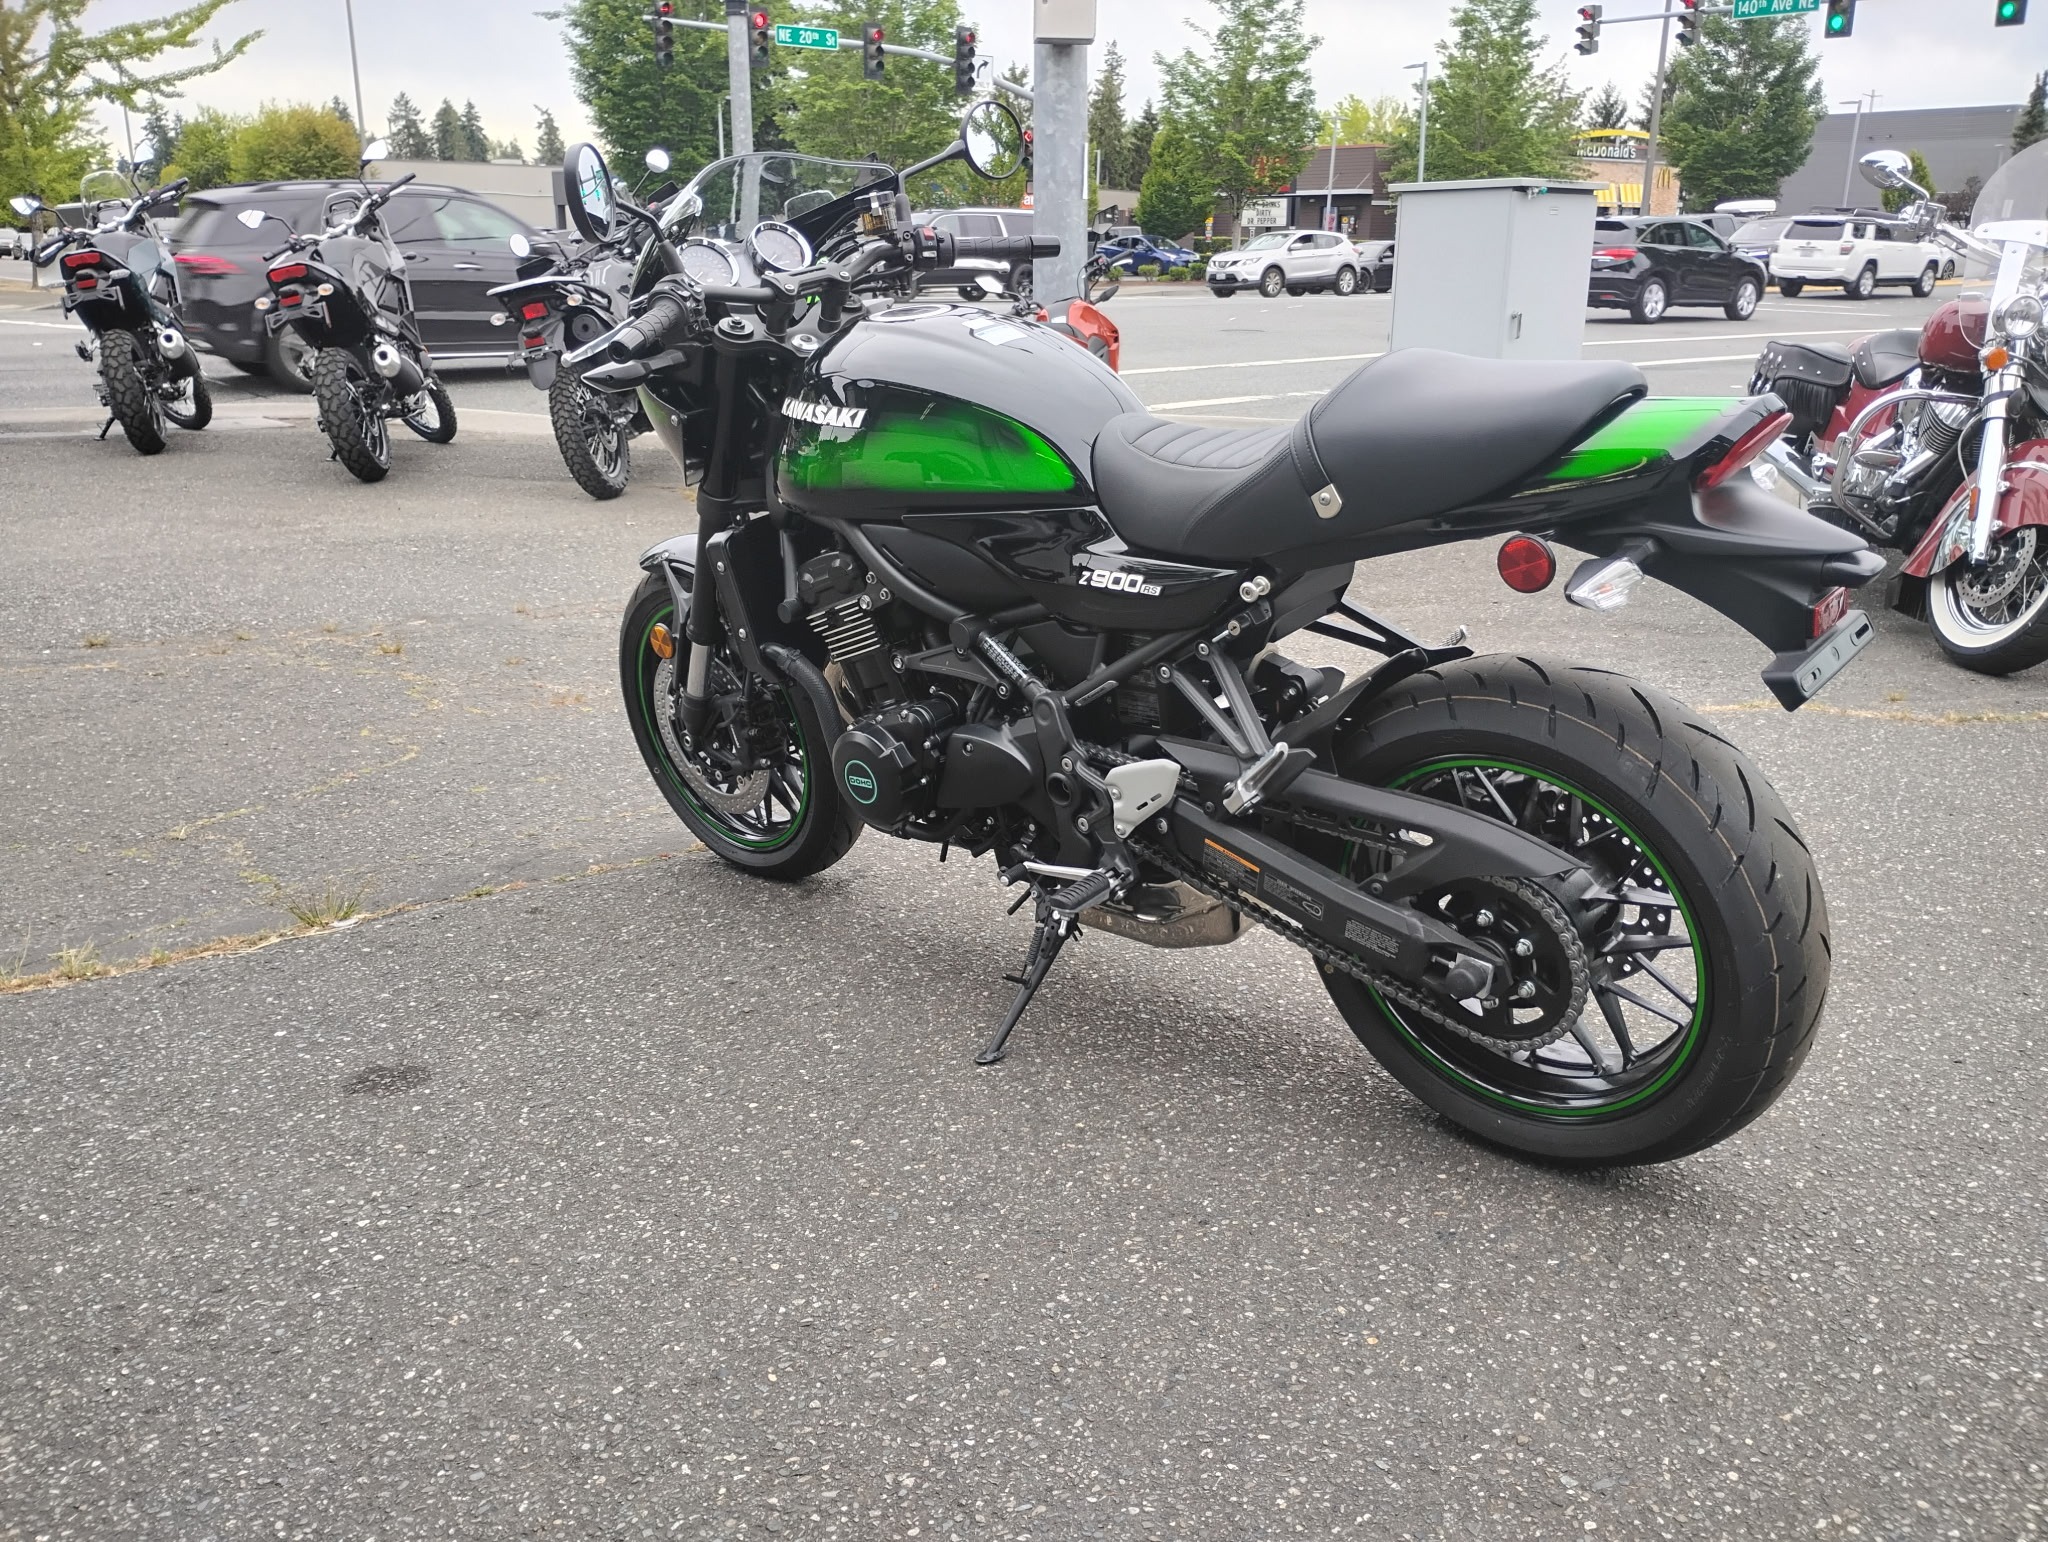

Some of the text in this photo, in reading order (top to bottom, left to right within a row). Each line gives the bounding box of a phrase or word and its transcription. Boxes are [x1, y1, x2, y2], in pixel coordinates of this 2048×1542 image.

[1737, 0, 1815, 15] 140th Ave NE
[778, 28, 836, 46] NE 20th St
[781, 397, 868, 428] KAWASAKI
